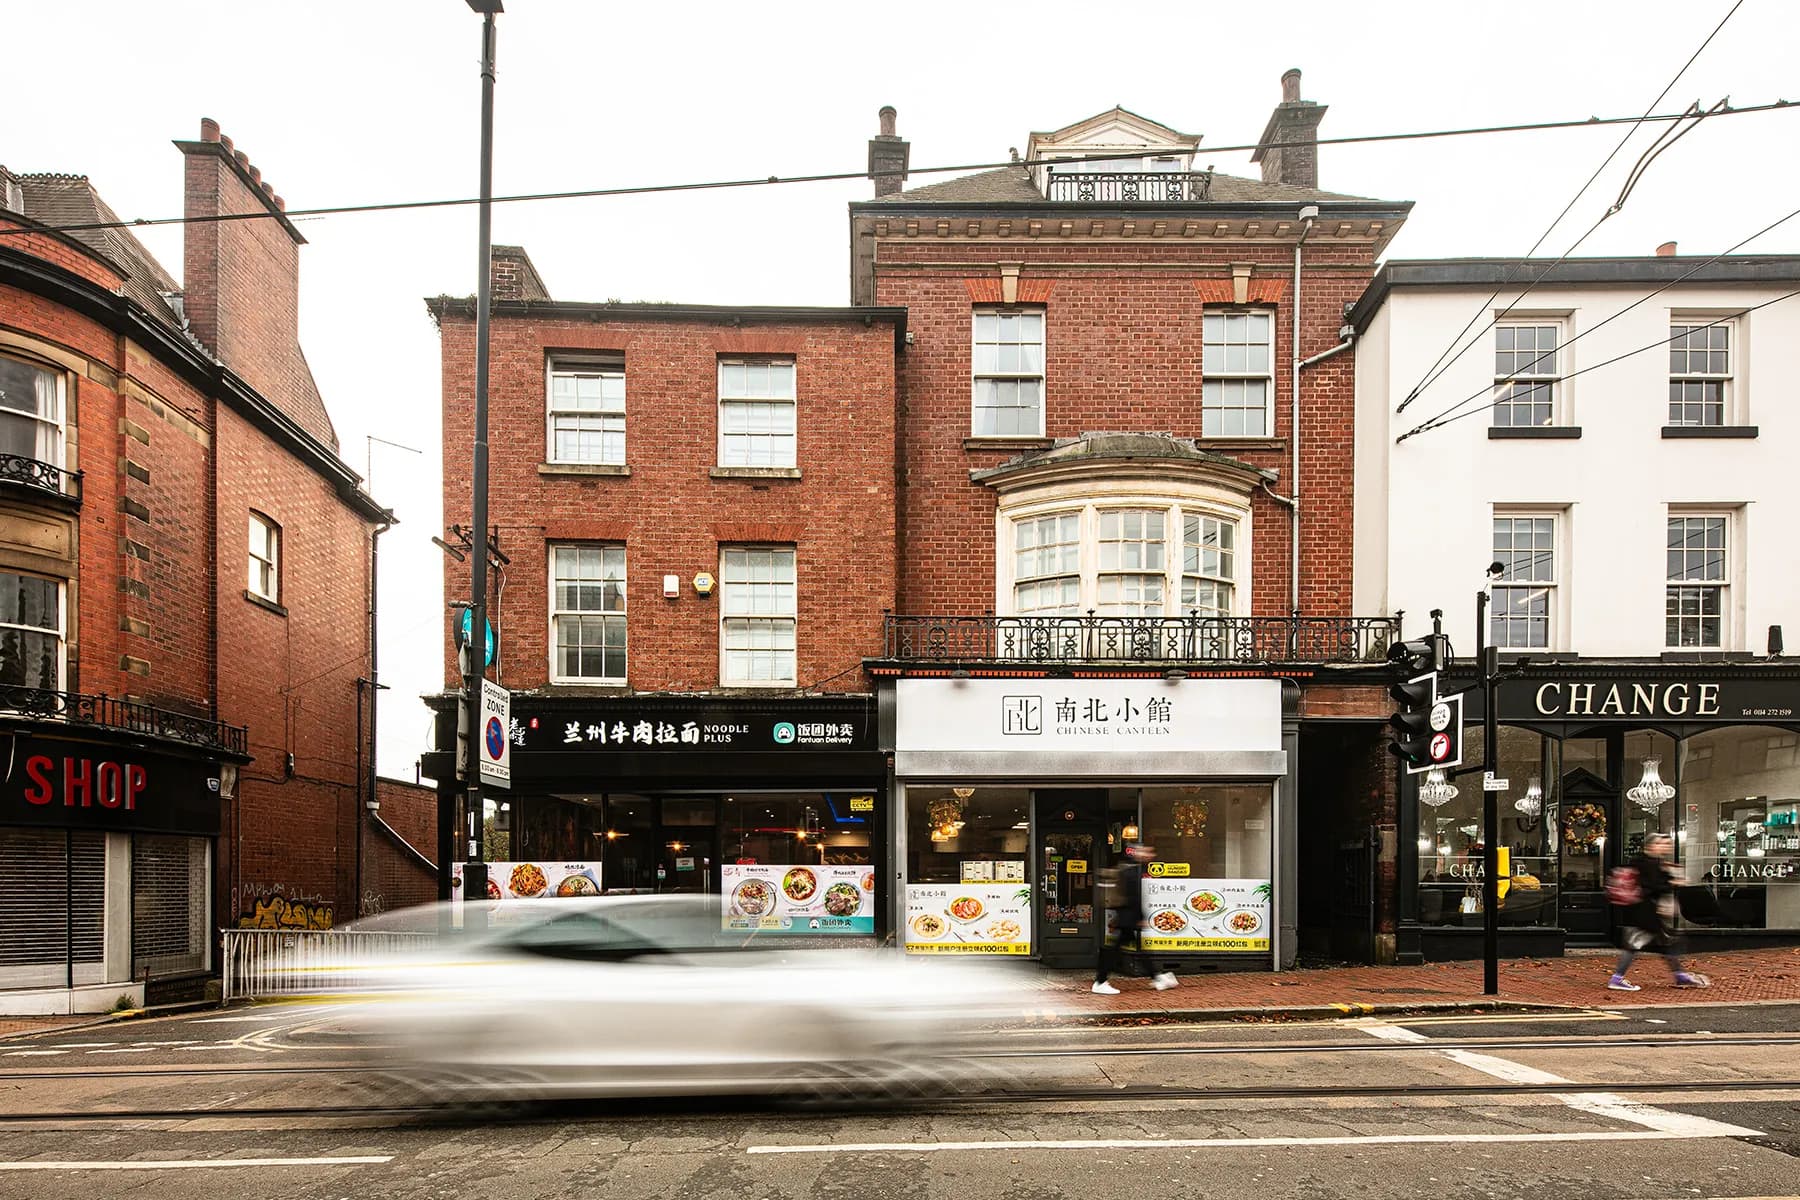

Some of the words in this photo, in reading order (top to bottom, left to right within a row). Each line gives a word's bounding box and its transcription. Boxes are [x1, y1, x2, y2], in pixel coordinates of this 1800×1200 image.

[484, 684, 508, 703] Controlled
[1536, 683, 1721, 715] CHANGE
[486, 698, 505, 716] ZONE
[1055, 697, 1172, 723] 南北小館
[563, 720, 700, 745] 兰州牛肉拉面
[703, 725, 749, 733] NOODLE
[797, 723, 853, 737] 饭团外卖
[1056, 727, 1109, 735] CHINESE
[1116, 727, 1170, 735] CANTEEN
[703, 734, 732, 743] PLUS
[825, 737, 853, 745] Delivery
[24, 755, 146, 810] SHOP
[1449, 863, 1530, 878] CHAE
[1711, 863, 1788, 878] CHANGE
